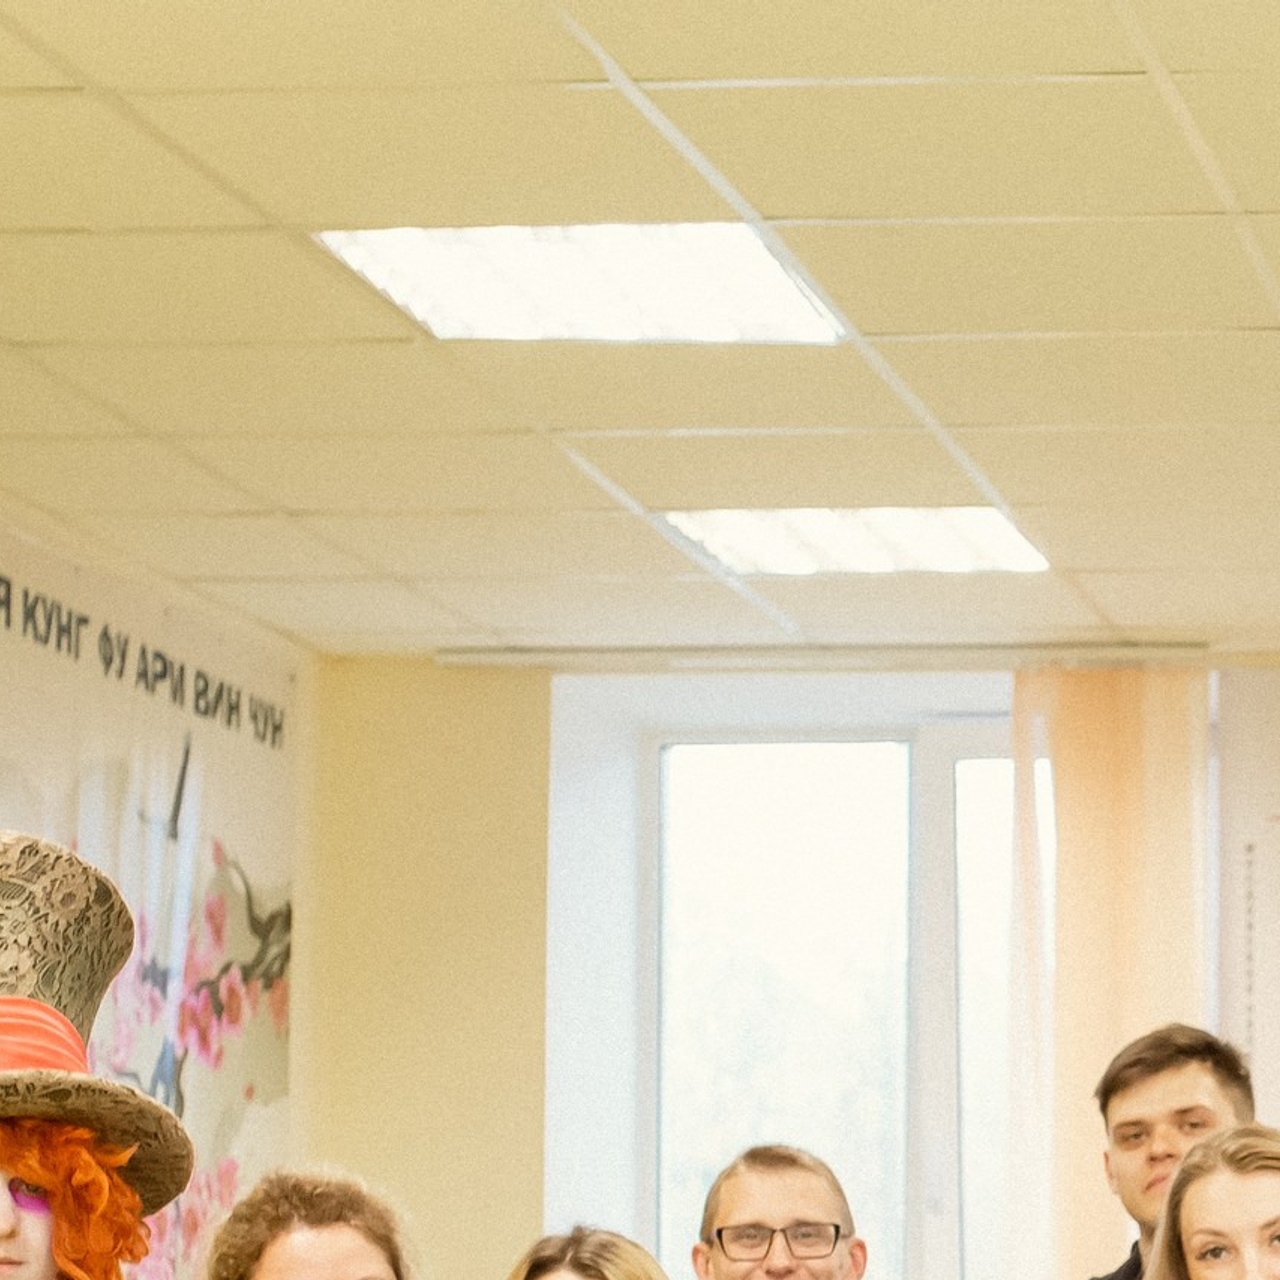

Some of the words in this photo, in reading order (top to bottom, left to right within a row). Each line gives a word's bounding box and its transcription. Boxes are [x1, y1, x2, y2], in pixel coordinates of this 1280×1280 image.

[22, 586, 90, 662] КУНГ
[97, 623, 130, 680] ФУ
[194, 669, 241, 731] ВИН
[249, 693, 285, 750] ЧУН
